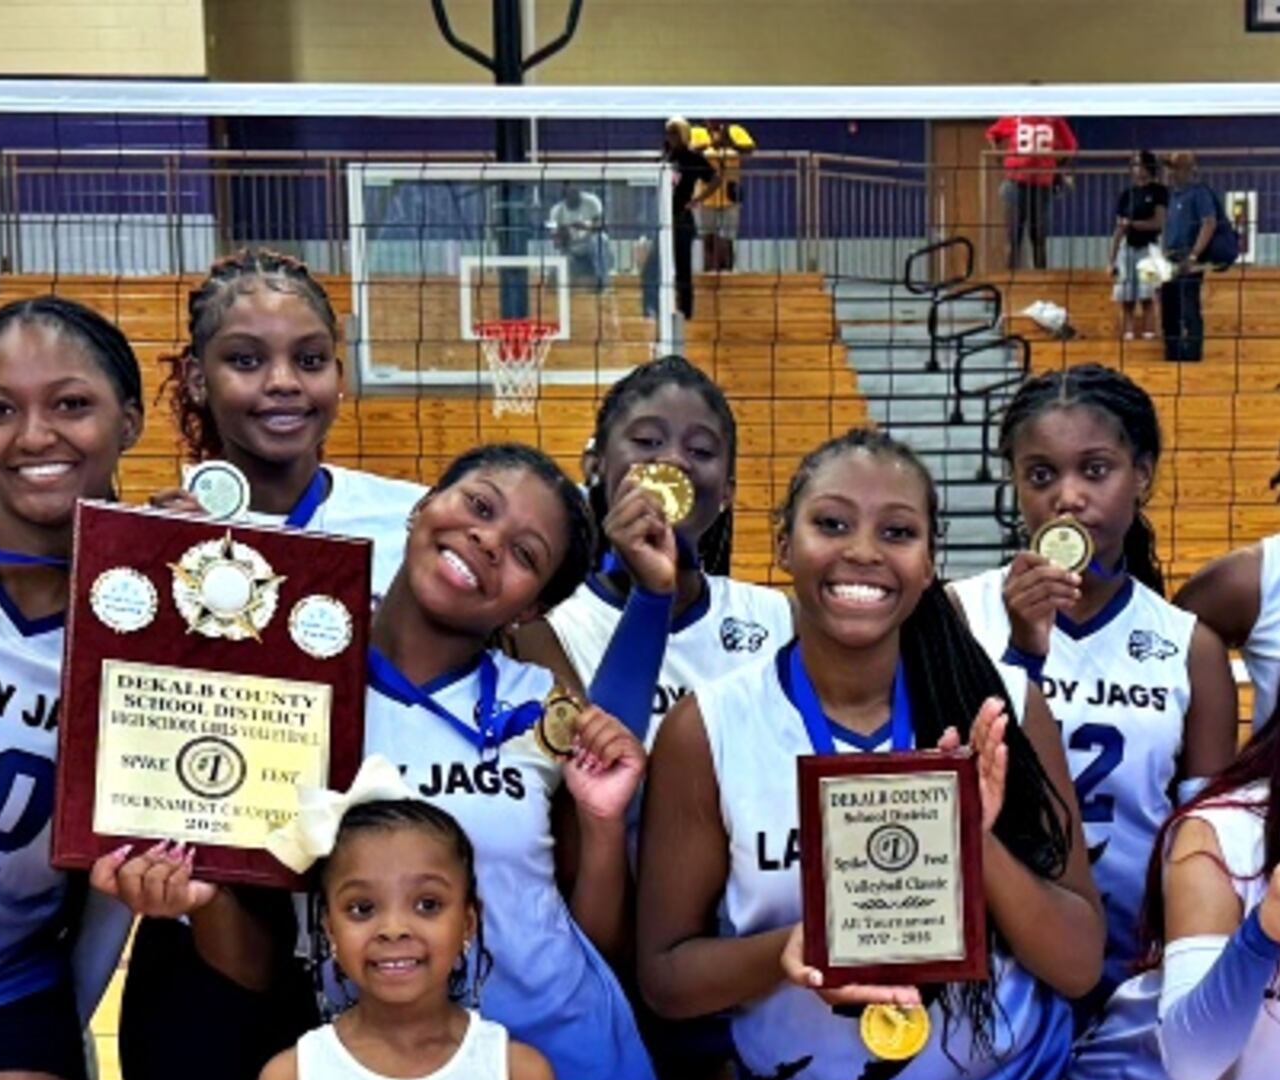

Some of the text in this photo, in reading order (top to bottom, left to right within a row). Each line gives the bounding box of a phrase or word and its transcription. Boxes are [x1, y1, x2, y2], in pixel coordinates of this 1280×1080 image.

[1017, 124, 1053, 154] 82
[118, 675, 317, 709] DEKALB COUNTY
[1087, 679, 1169, 712] JAGS
[124, 693, 308, 727] SCHOOL DISTRICT
[418, 762, 526, 801] JAGS
[891, 787, 949, 805] COUNTY
[111, 792, 216, 815] TOURNAMENT
